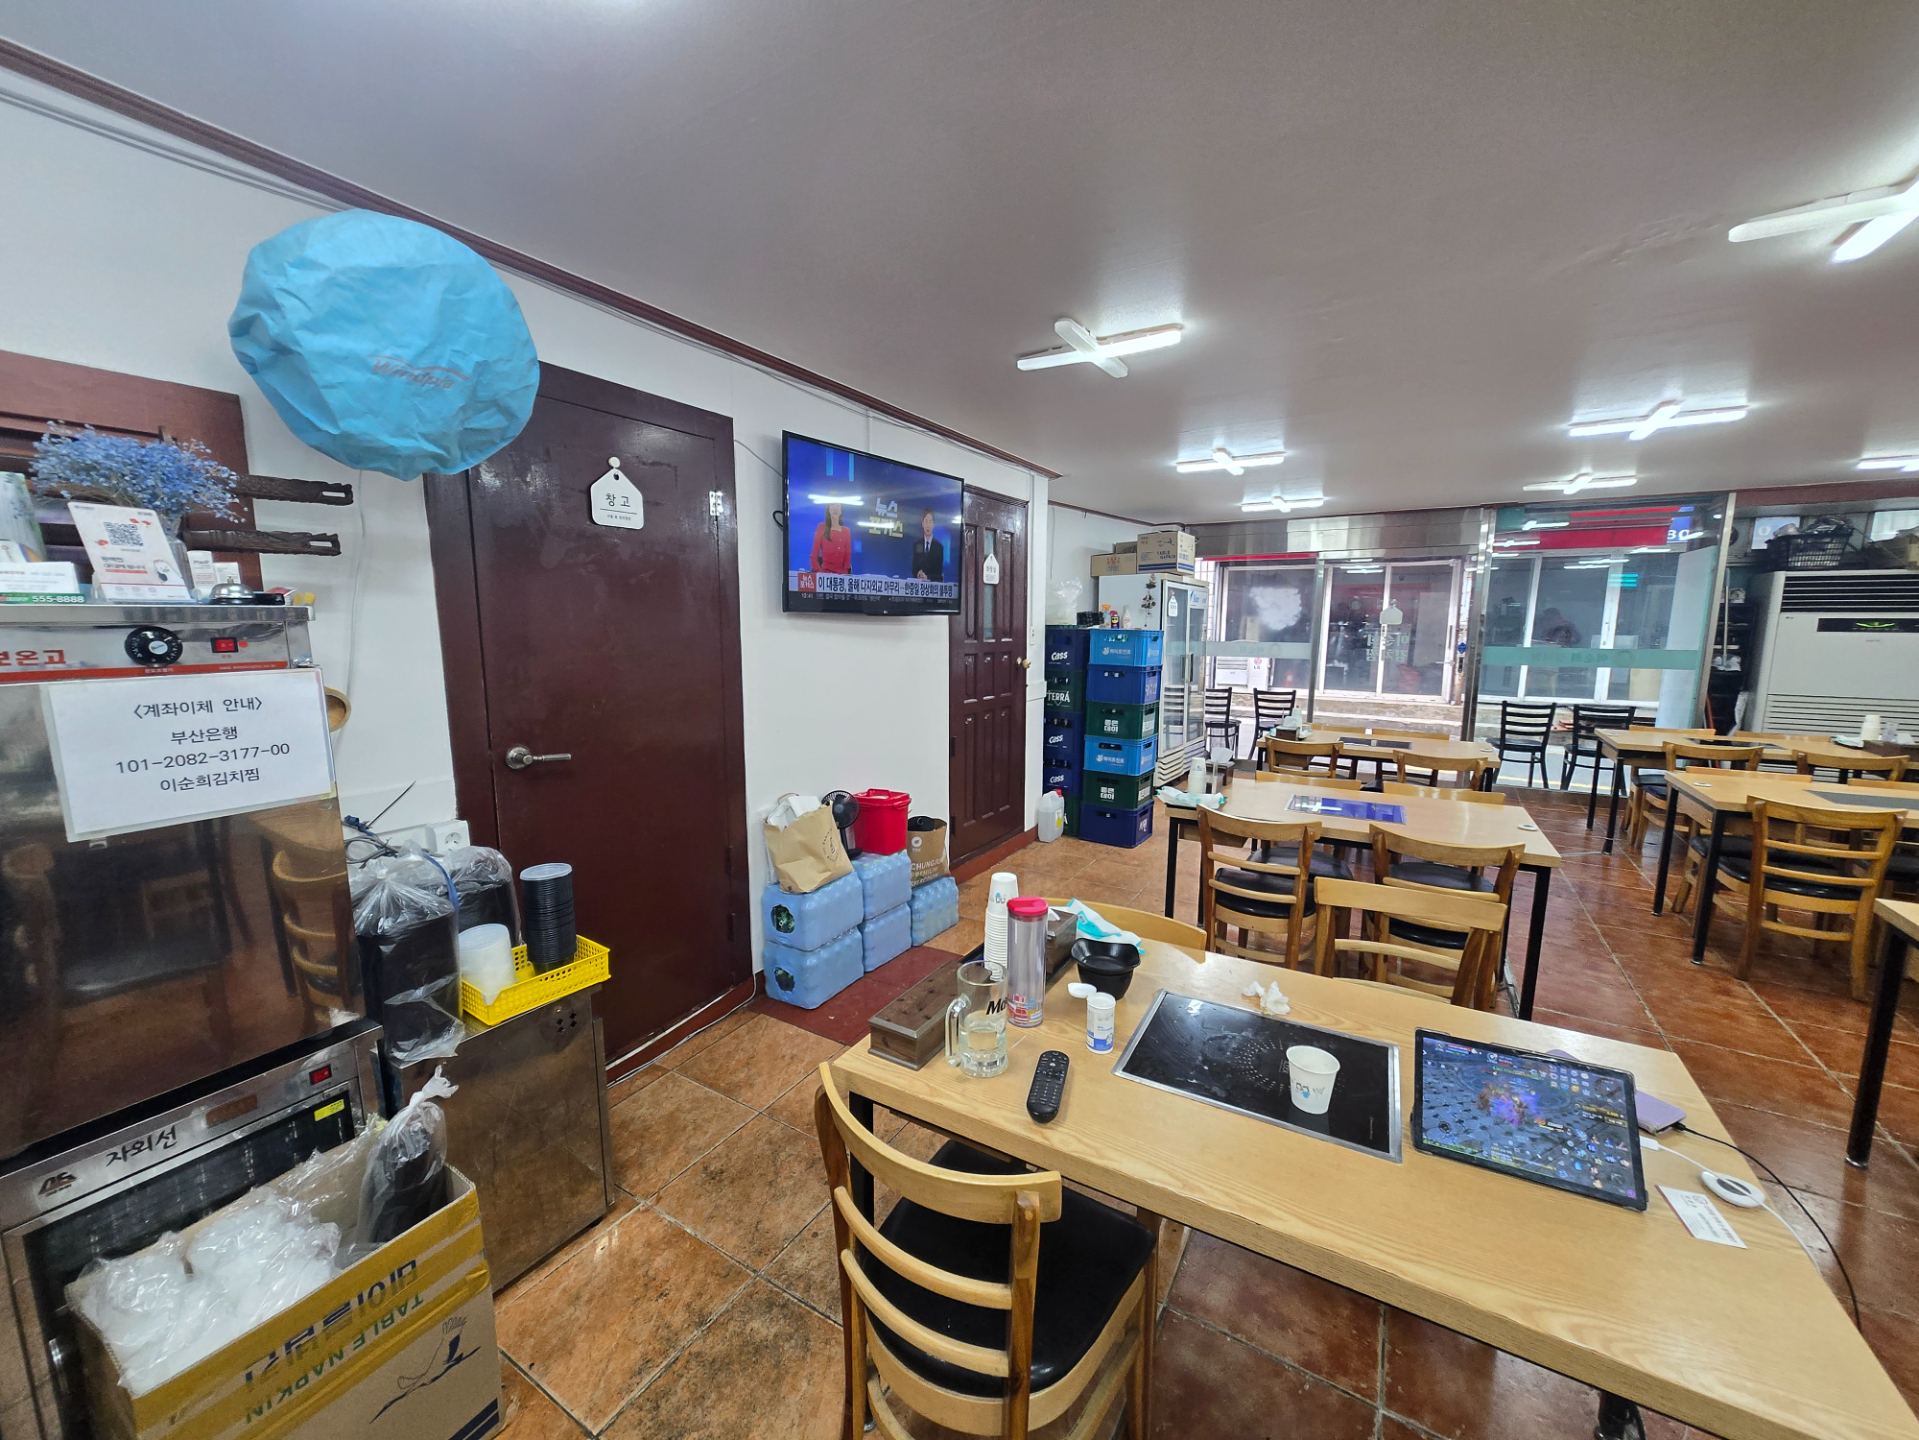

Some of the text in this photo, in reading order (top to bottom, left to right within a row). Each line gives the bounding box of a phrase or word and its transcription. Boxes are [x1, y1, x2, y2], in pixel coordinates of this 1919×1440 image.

[875, 497, 898, 519] 뉴스
[818, 576, 825, 591] 이
[826, 577, 847, 594] 대통령,
[847, 578, 860, 593] 올해
[32, 595, 85, 603] 555-8888
[1051, 651, 1068, 661] Cass
[170, 725, 238, 745] 부산은행
[1048, 734, 1064, 744] Cass
[115, 743, 290, 774] 101-2082-3177-00
[160, 767, 260, 792] 이순희김치찜
[1049, 775, 1065, 784] Cass
[106, 1126, 177, 1167] 자외선
